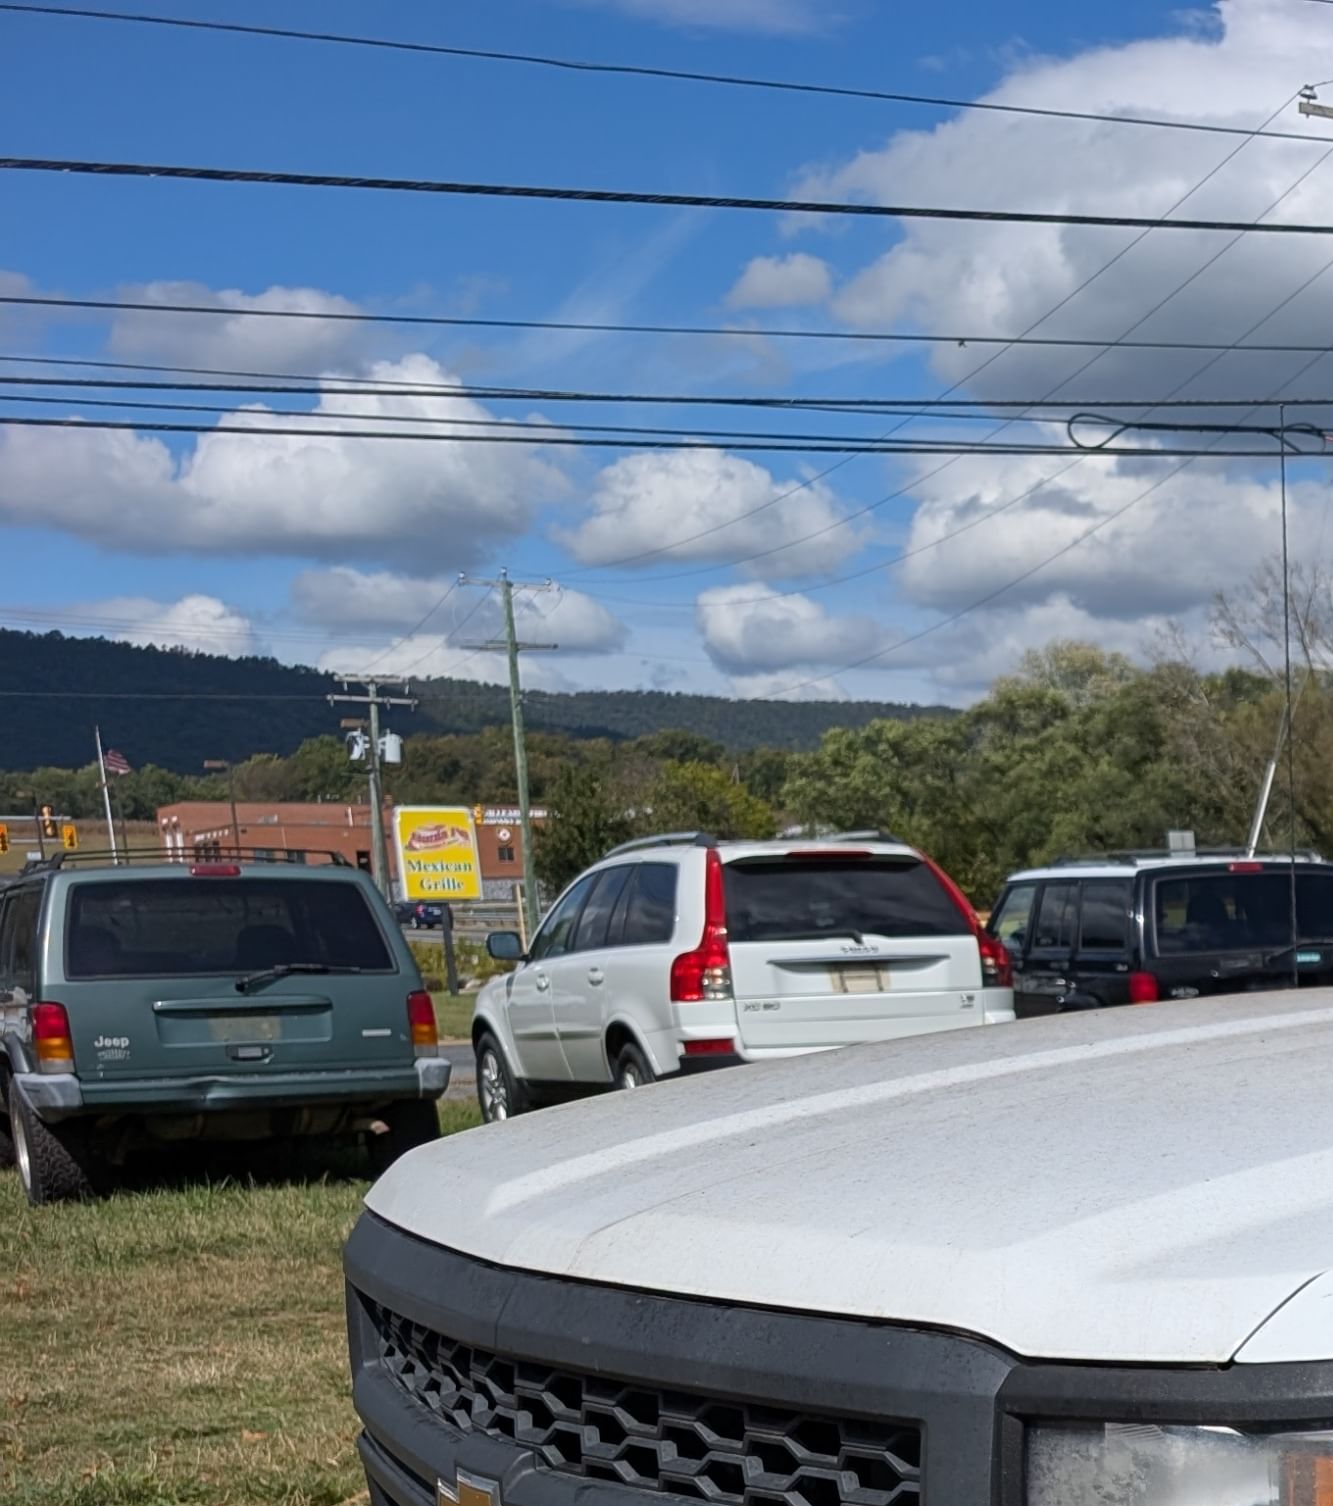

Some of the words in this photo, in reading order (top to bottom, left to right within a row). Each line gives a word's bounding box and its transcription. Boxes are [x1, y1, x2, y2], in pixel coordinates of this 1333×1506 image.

[408, 859, 472, 873] Mexican
[420, 878, 464, 891] Grille
[94, 1035, 130, 1049] Jeep
